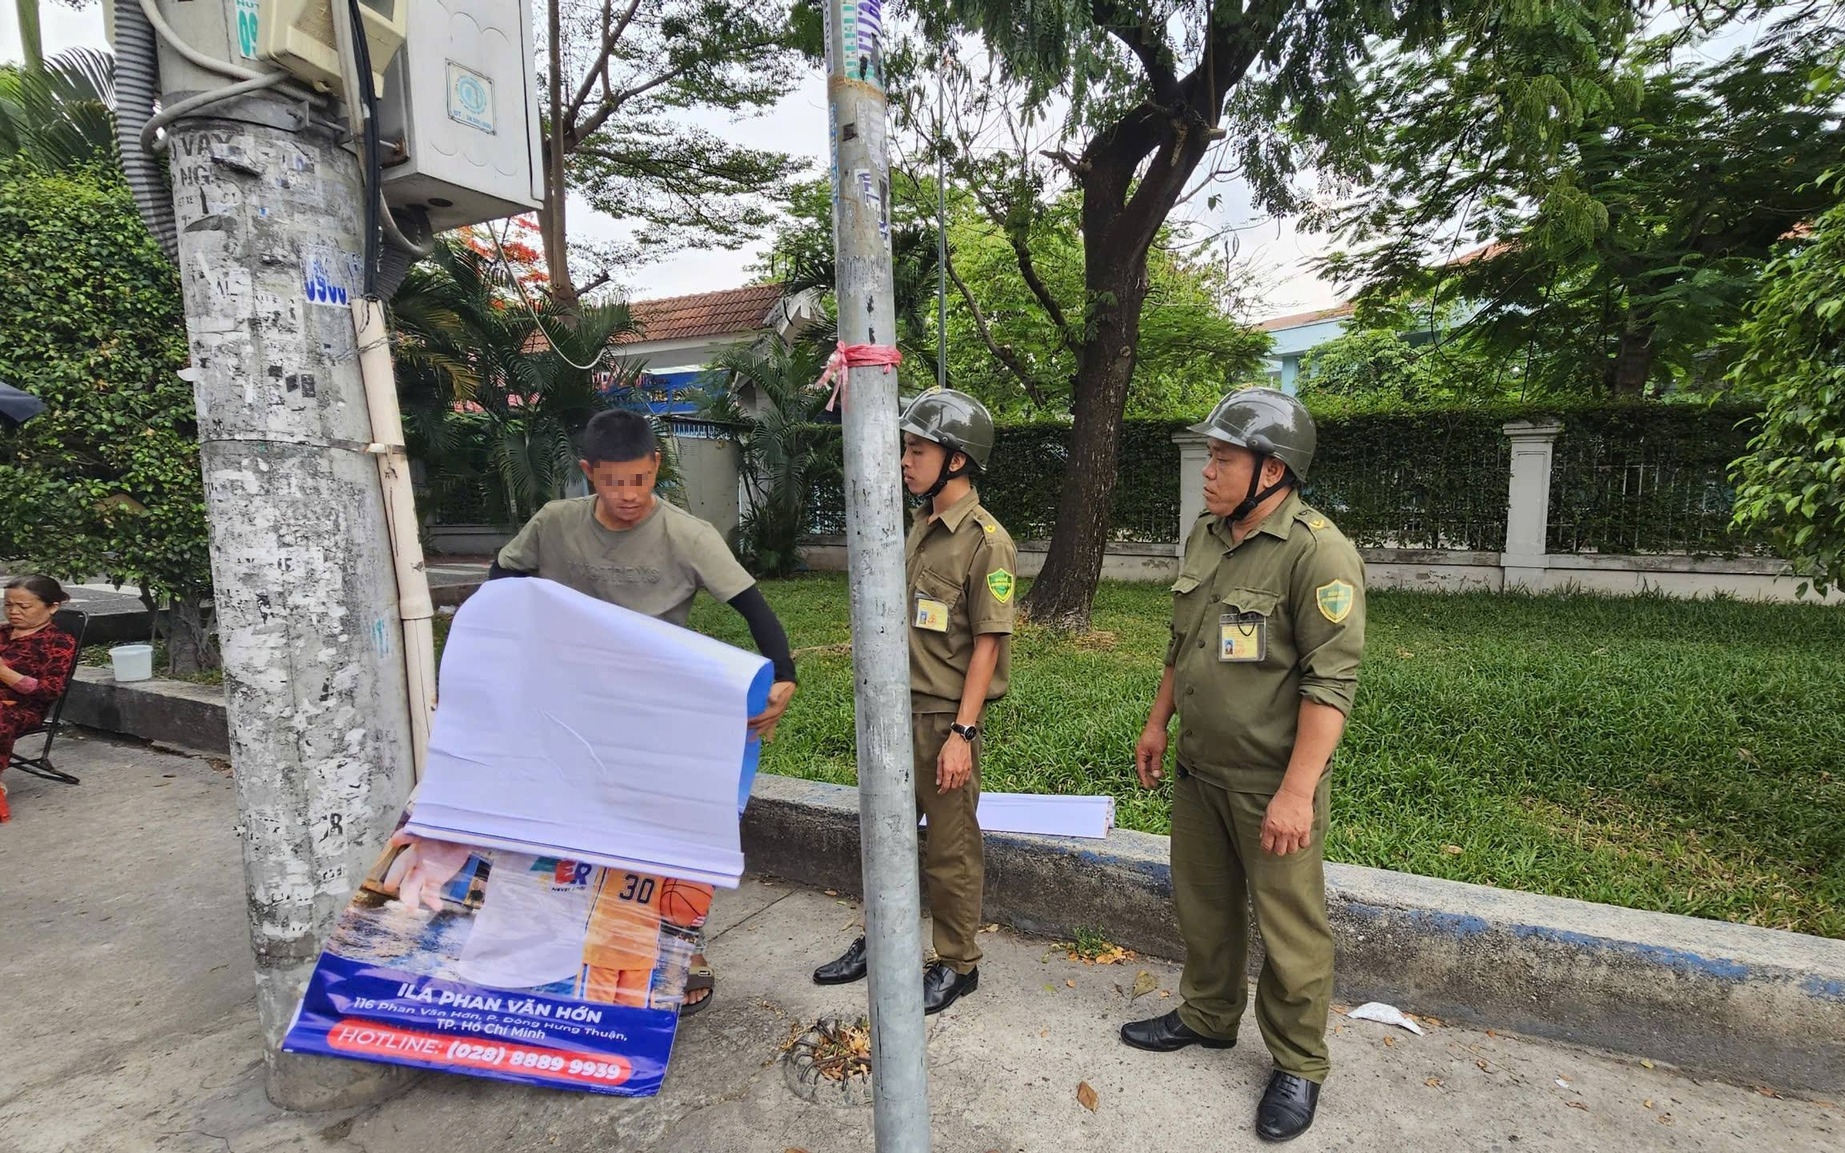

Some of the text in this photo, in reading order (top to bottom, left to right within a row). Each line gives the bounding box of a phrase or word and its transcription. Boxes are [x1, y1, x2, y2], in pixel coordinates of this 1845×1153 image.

[619, 874, 655, 904] 30
[353, 996, 376, 1010] 116
[377, 1002, 416, 1014] Phan
[544, 1022, 581, 1035] Hưng
[397, 983, 602, 1024] ILA PHAN VĂN HỚN
[437, 1018, 457, 1030] TP.
[484, 1023, 507, 1036] Chí
[511, 1025, 546, 1040] Minh
[337, 1026, 621, 1080] HOTLINE: (028) 8889 9939
